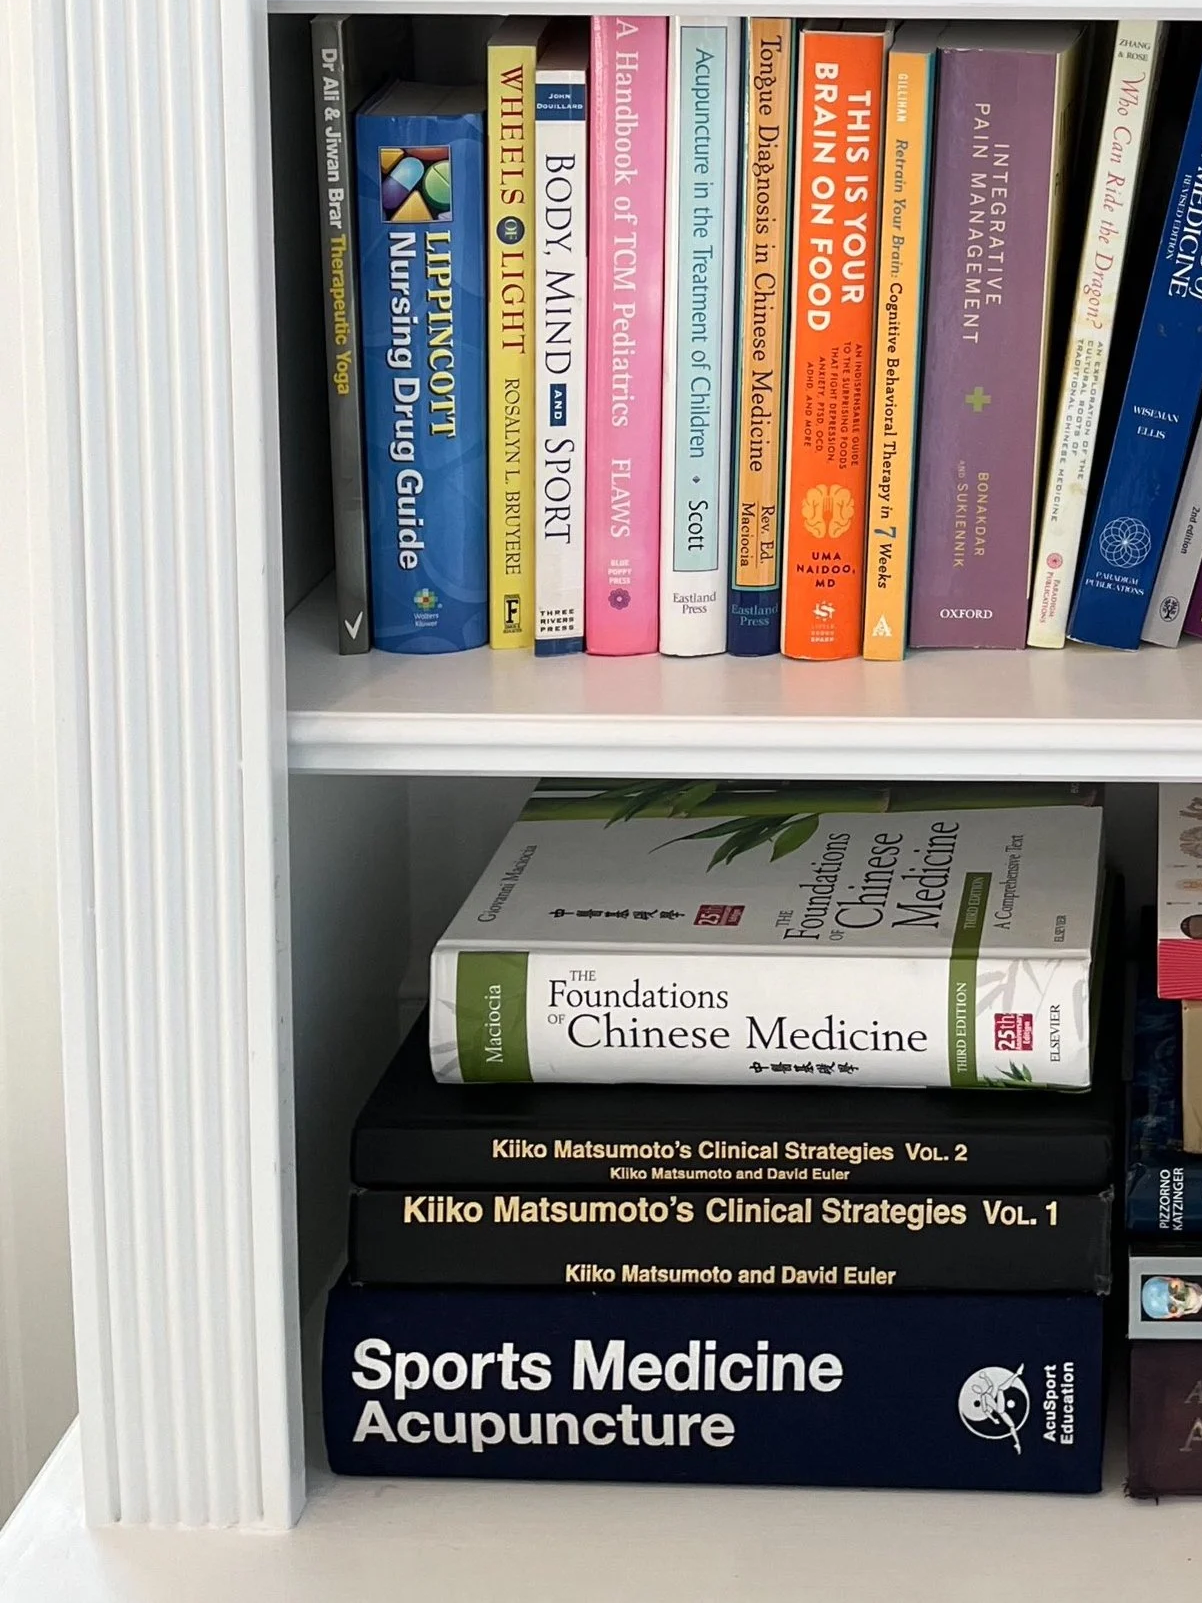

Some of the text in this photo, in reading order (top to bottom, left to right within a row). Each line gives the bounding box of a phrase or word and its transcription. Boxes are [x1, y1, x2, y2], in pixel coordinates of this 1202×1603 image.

[499, 63, 525, 354] WHEELS OF LIGHT
[807, 62, 838, 330] BRAIN ON FOOD
[840, 90, 871, 302] THIS IS YOUR
[962, 102, 991, 343] PAIN MANAGEMENT
[985, 143, 1010, 305] INTEGRATIVE
[423, 229, 456, 437] LIPPINCOTT
[543, 153, 575, 544] BODY, MIND AND SPORT
[384, 231, 425, 570] Nursing Drug Guide
[610, 457, 631, 538] FLAWS
[796, 563, 855, 574] NAIDOO,
[811, 551, 841, 561] UMA
[814, 578, 835, 587] MD
[939, 608, 993, 619] OXFORD
[548, 979, 728, 1009] Foundations
[569, 969, 596, 981] THE
[483, 984, 503, 1062] Maciocia
[546, 1011, 927, 1052] OF Chinese Medicine
[1049, 1003, 1060, 1062] ELSEVIER
[403, 1195, 1057, 1230] Kiiko Matsumoto's Clinical Strategies VOL. 1
[1158, 1166, 1172, 1228] PIZZORNO
[1171, 1164, 1185, 1230] KATZINGER
[351, 1337, 843, 1400] Sports Medicine
[352, 1401, 735, 1451] Acupuncture
[1042, 1364, 1059, 1442] AcuSport
[1060, 1361, 1074, 1444] Education
